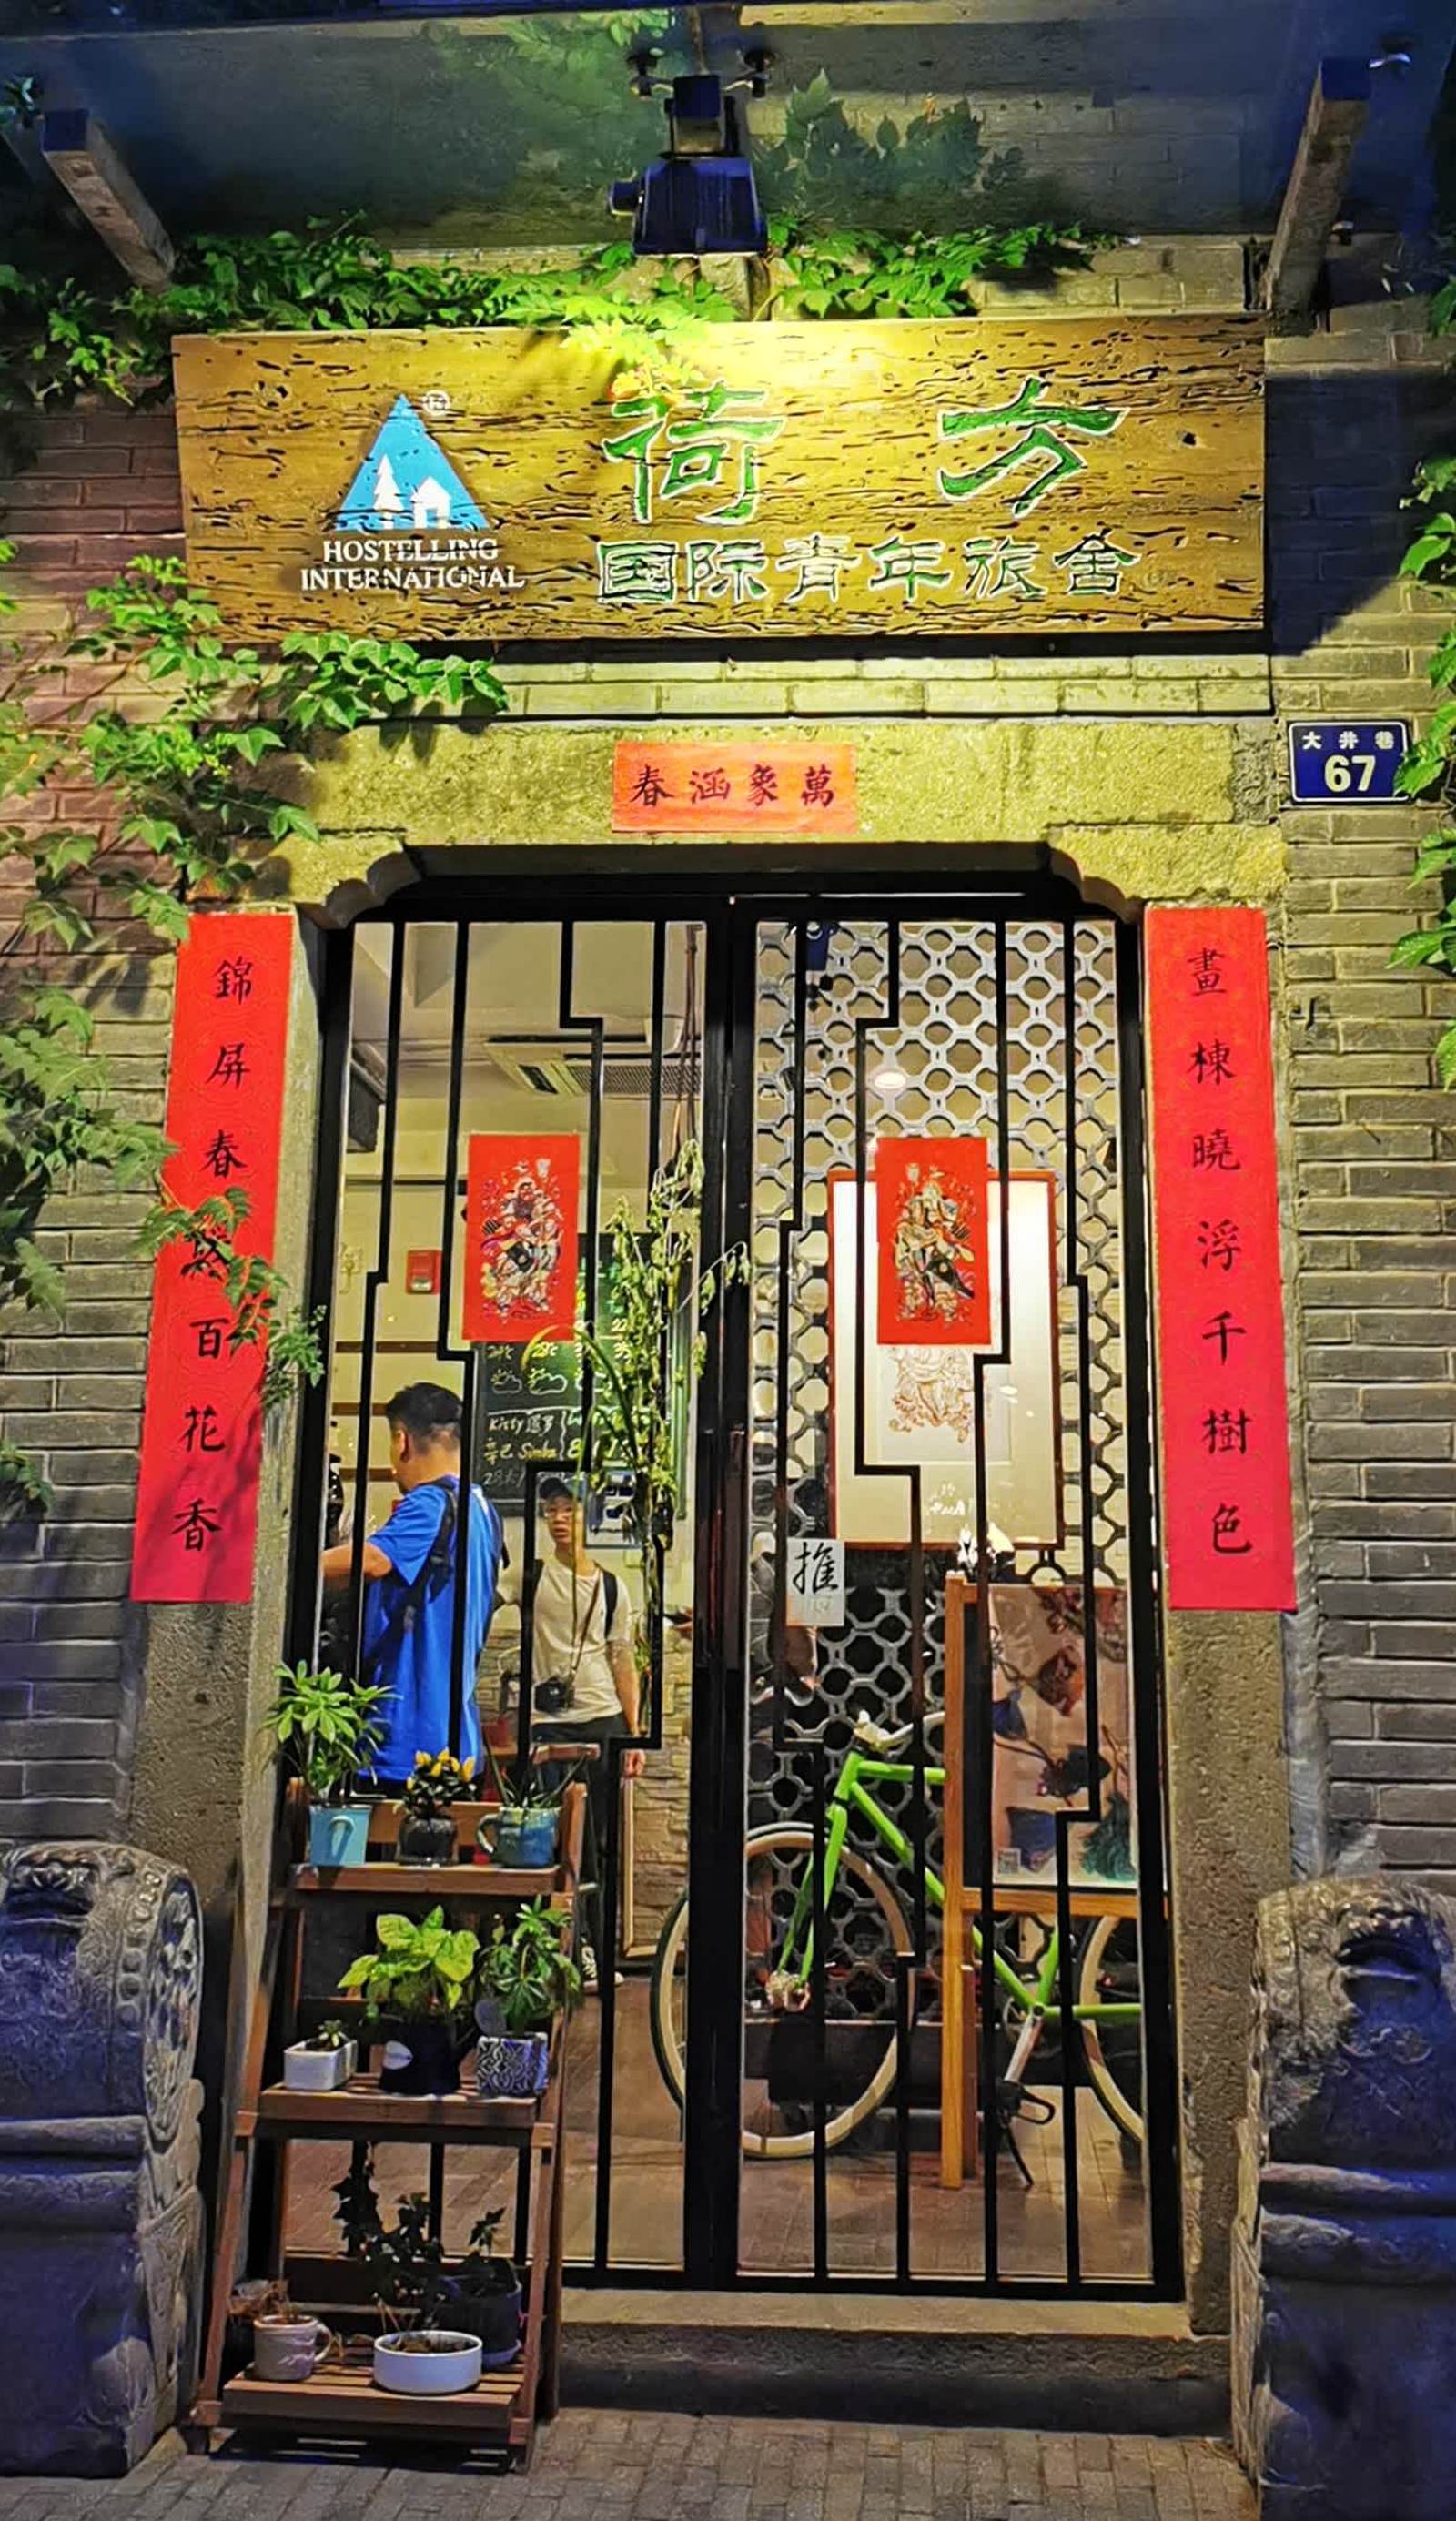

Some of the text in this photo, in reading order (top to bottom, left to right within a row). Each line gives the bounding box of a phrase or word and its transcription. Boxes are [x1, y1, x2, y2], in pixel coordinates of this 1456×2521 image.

[322, 538, 499, 563] HOSTELLING
[596, 524, 1142, 605] 国际青年旅舍
[300, 565, 526, 592] INTERNATIONAL
[1301, 730, 1395, 751] 大井巷
[1323, 754, 1377, 793] 67
[1186, 947, 1254, 1554] 畫棟曉浮千樹色
[792, 1541, 839, 1595] 推
